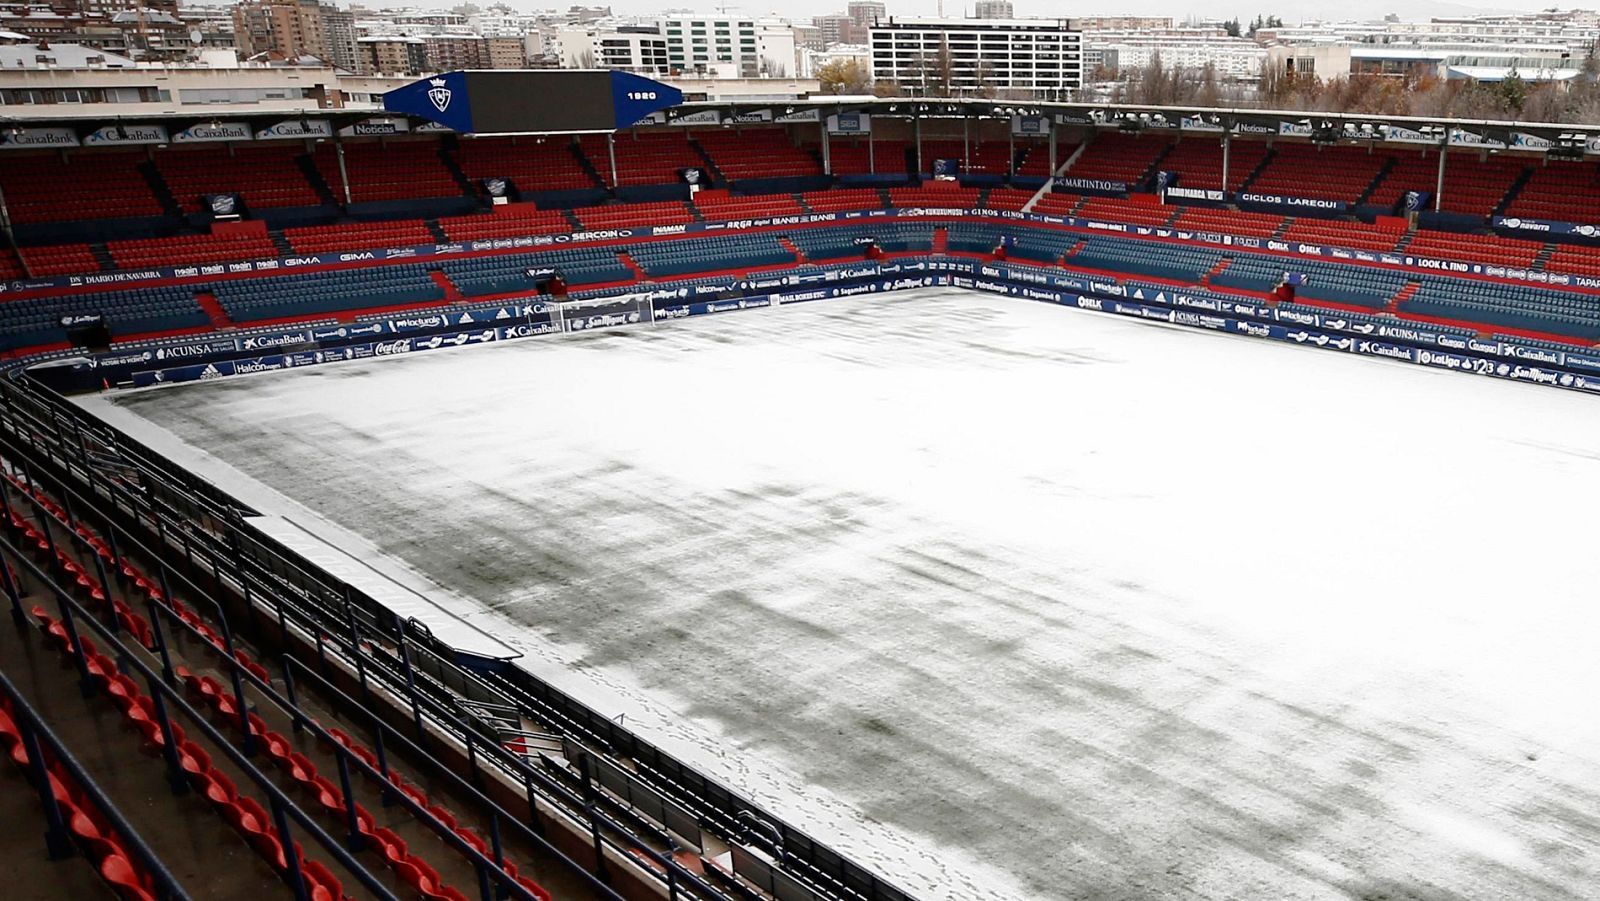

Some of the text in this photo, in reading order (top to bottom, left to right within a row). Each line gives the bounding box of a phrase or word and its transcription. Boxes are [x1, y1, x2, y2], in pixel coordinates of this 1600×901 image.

[627, 92, 656, 100] 1920
[194, 127, 246, 139] CaixaBank
[356, 124, 395, 134] Noticias
[14, 133, 73, 146] CaixaBank
[1064, 178, 1112, 191] MARTINTXO
[1242, 193, 1337, 209] CICLOS LAREQUI
[971, 208, 998, 216] GINOS
[1002, 210, 1024, 219] GINOS
[727, 219, 752, 229] ARGA
[1520, 222, 1550, 232] navarra
[571, 230, 618, 241] SERCOIN
[284, 256, 321, 266] GIMA
[339, 251, 375, 261] GIMA
[1418, 258, 1469, 272] LOOK & FIND
[85, 271, 161, 284] DIARIO DE NAVARRA
[1187, 298, 1217, 310] CaixaBank
[517, 323, 562, 337] CaixaBank
[1385, 328, 1419, 341] ACUNSA
[257, 333, 306, 347] CaixaBank
[165, 344, 212, 358] ACUNSA
[1370, 342, 1412, 360] CaixaBank
[1516, 347, 1557, 363] CaixaBank
[1431, 354, 1461, 368] LaLiga
[236, 363, 267, 374] Halcon
